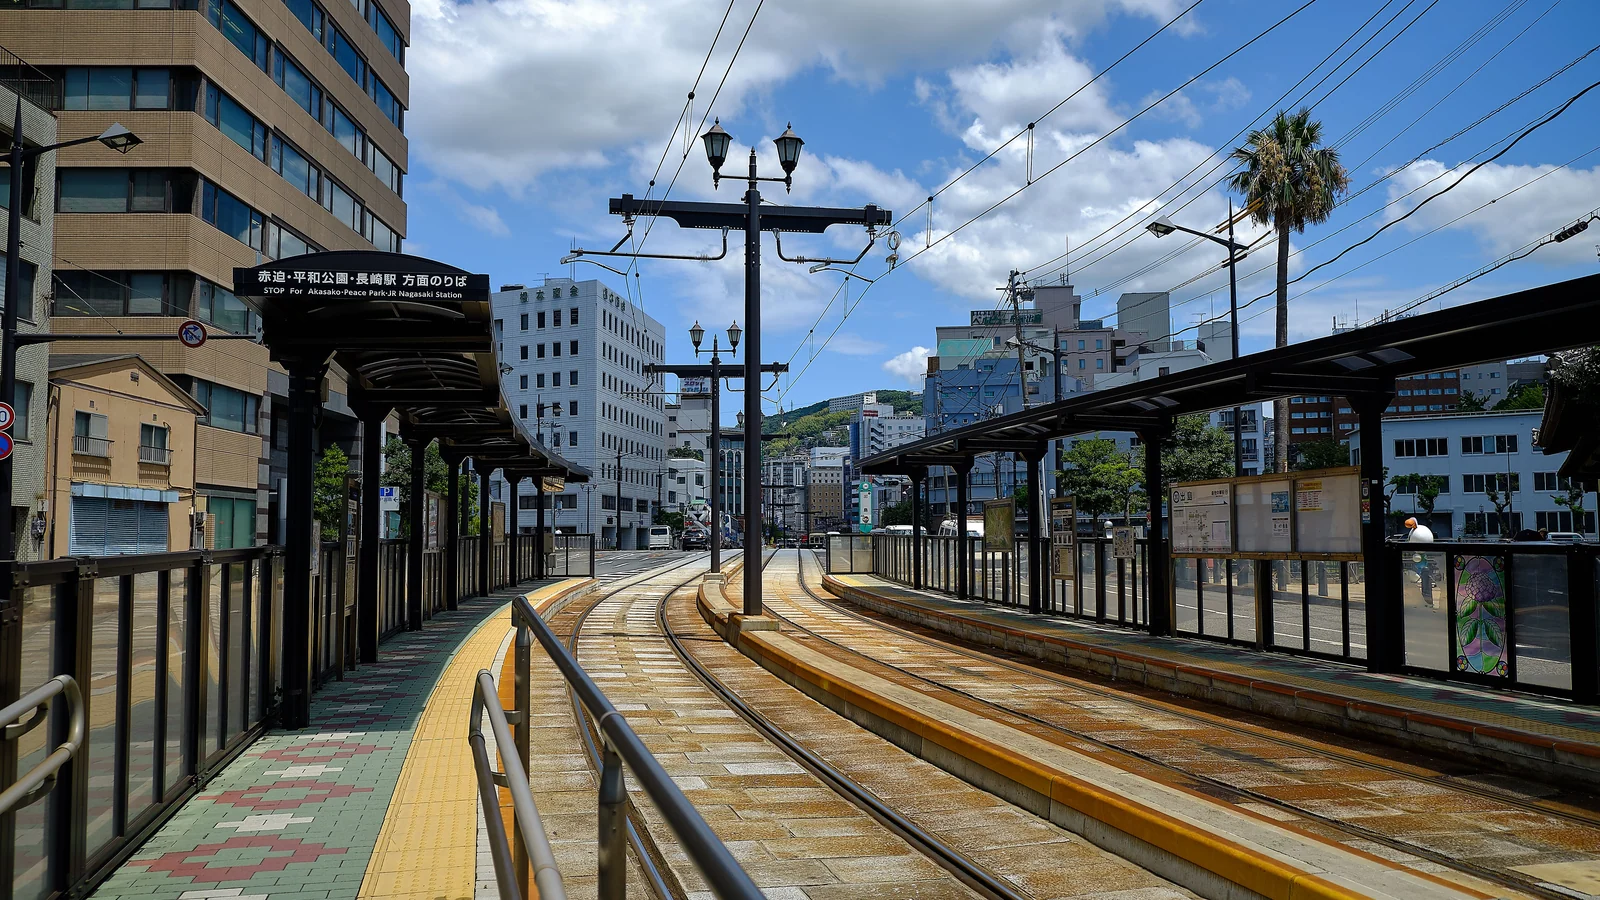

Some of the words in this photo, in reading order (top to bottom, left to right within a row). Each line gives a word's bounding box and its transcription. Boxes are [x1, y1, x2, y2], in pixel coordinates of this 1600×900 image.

[258, 270, 397, 286] 赤迫・平和公園・長崎駅
[402, 274, 468, 287] 方面のりば
[289, 287, 303, 295] For
[398, 290, 434, 299] Nagasaki
[435, 291, 463, 299] Station
[384, 488, 390, 496] P
